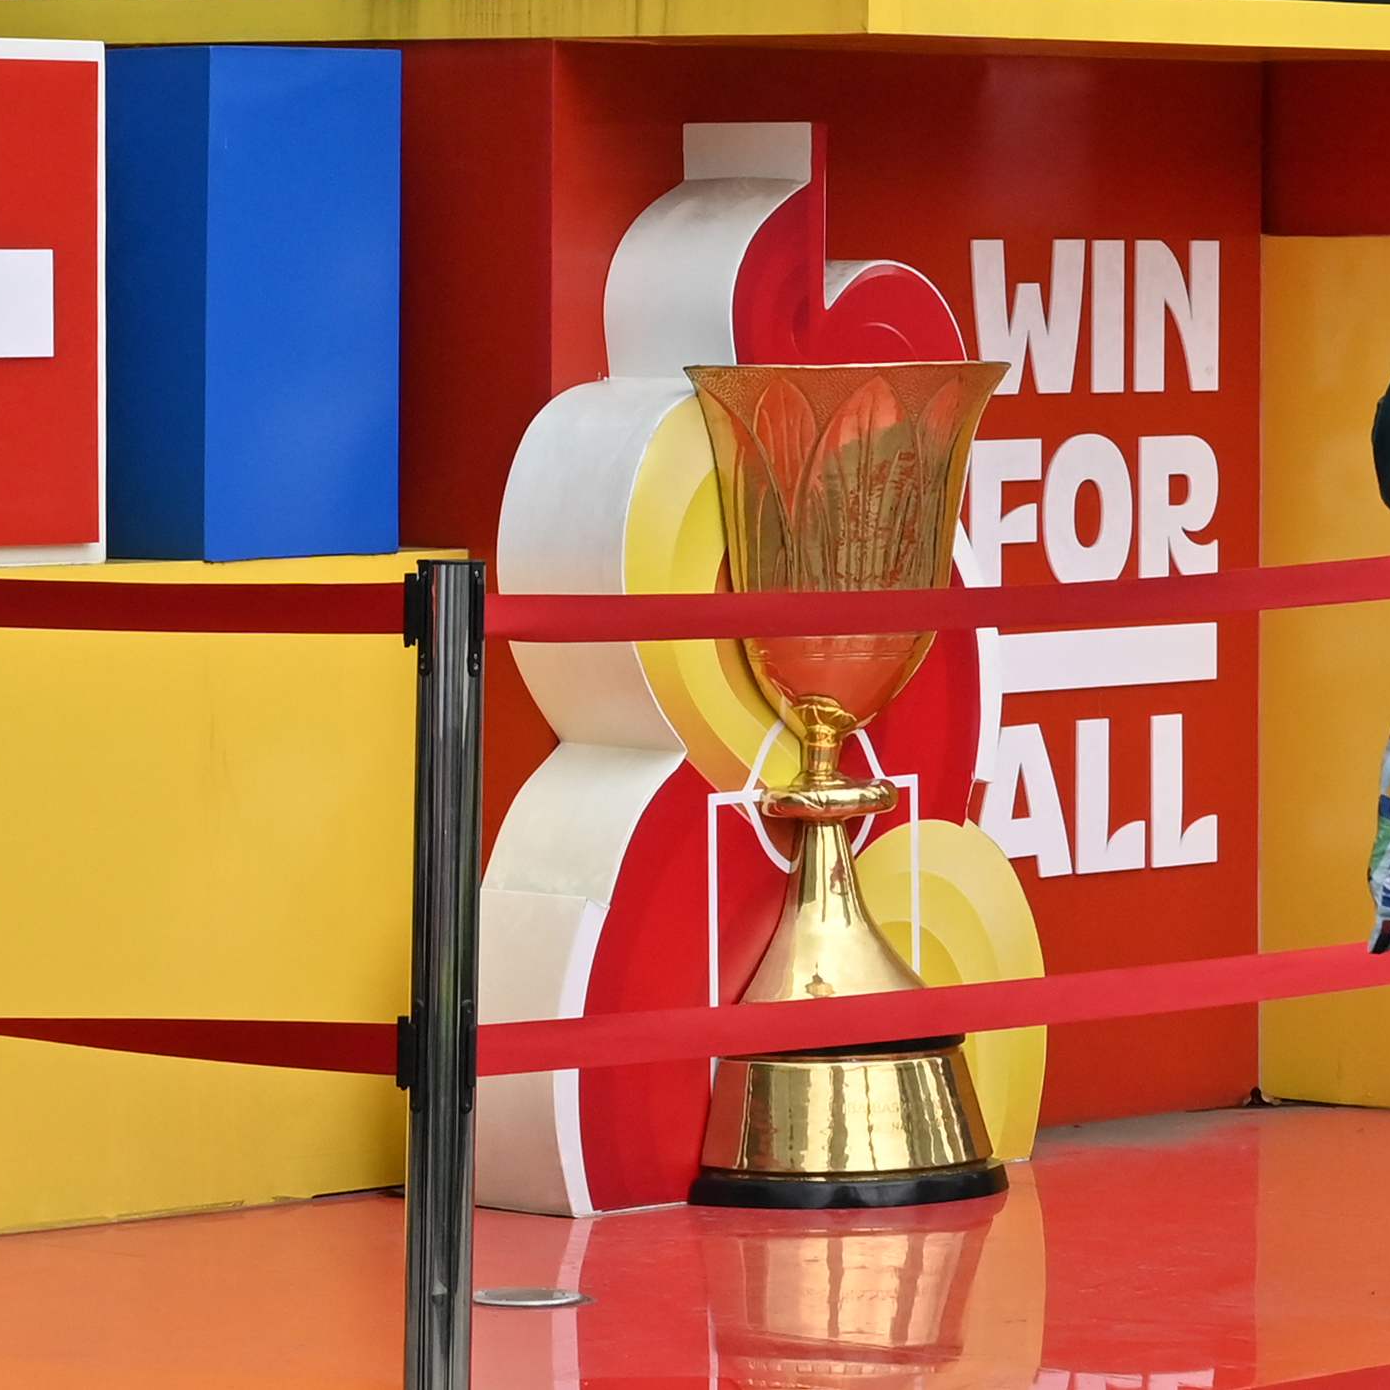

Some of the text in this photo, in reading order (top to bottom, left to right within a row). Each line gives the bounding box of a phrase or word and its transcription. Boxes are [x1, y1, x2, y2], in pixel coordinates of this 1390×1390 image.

[970, 237, 1220, 395] WIN
[968, 432, 1219, 589] FOR
[977, 712, 1219, 879] ALL
